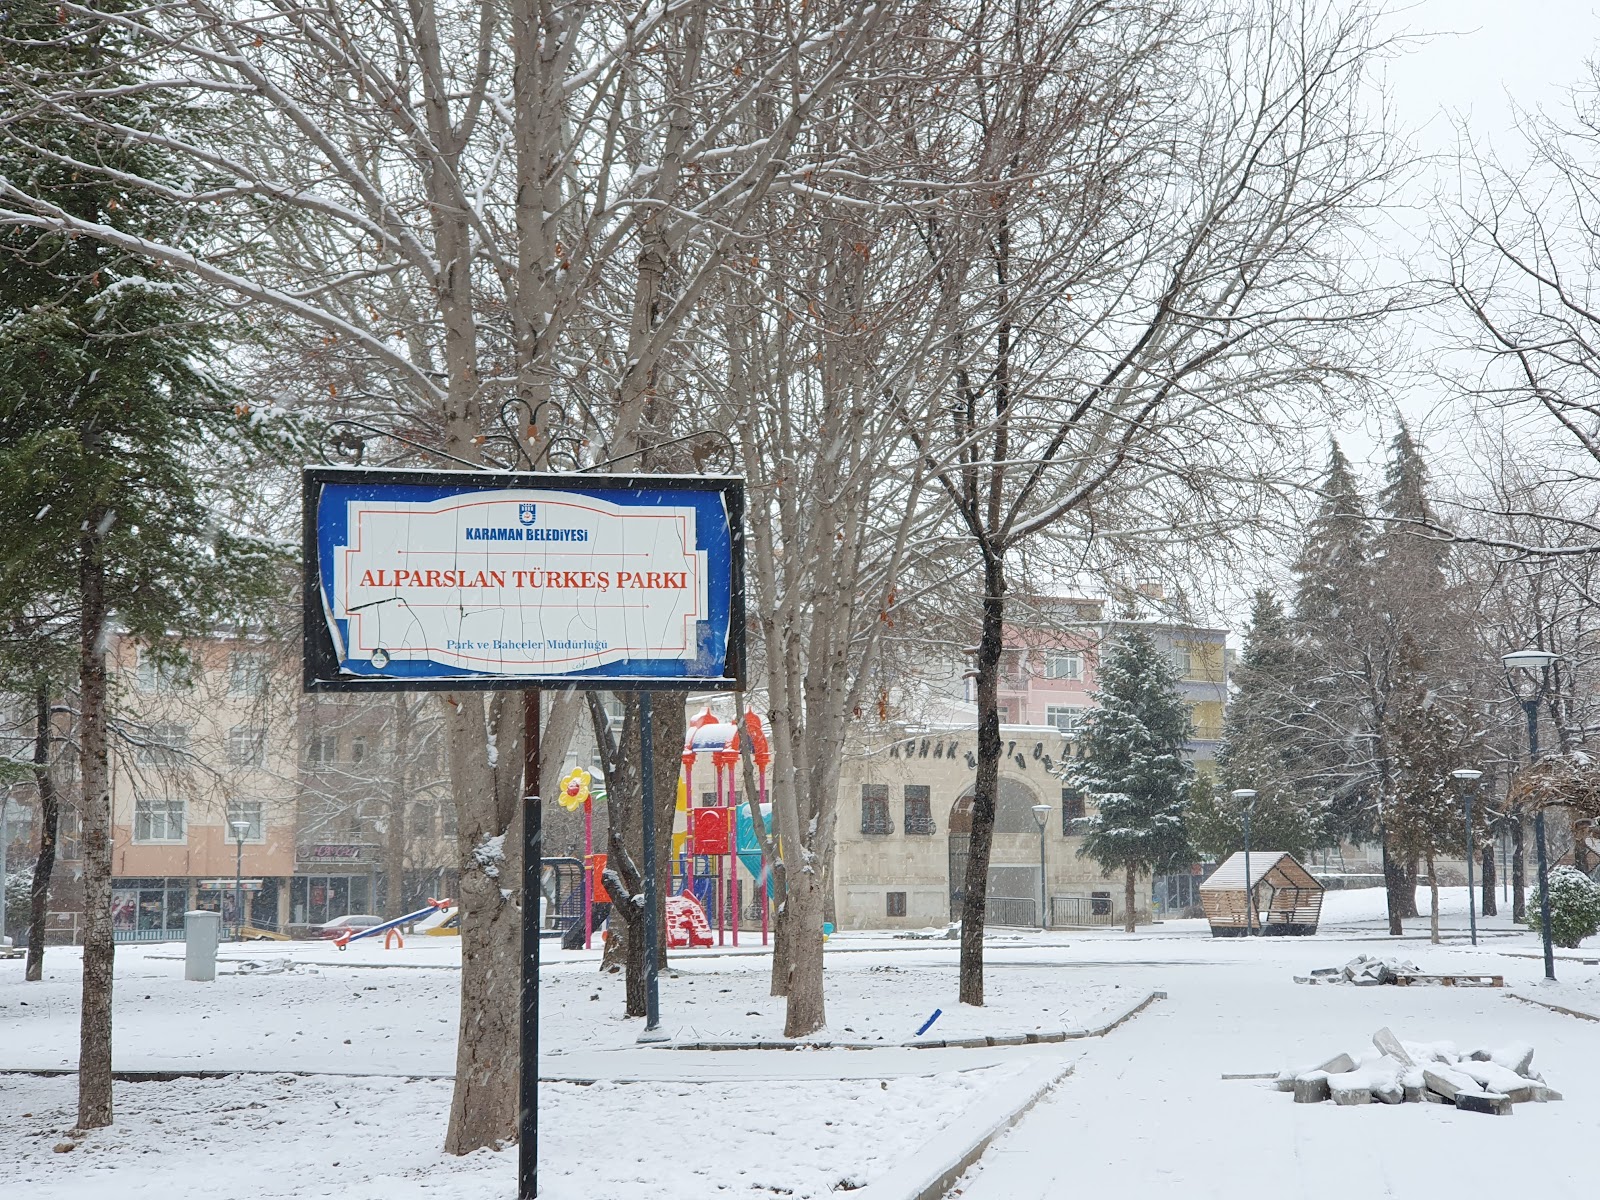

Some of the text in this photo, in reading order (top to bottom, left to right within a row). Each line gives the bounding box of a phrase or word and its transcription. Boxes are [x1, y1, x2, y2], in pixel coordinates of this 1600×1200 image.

[465, 527, 523, 541] KARAMAN
[359, 567, 688, 593] ALPARSLAN TÜRKEŞ PARKI
[446, 639, 474, 650] Park
[476, 642, 490, 650] ve
[546, 639, 609, 652] Müdürlüğü
